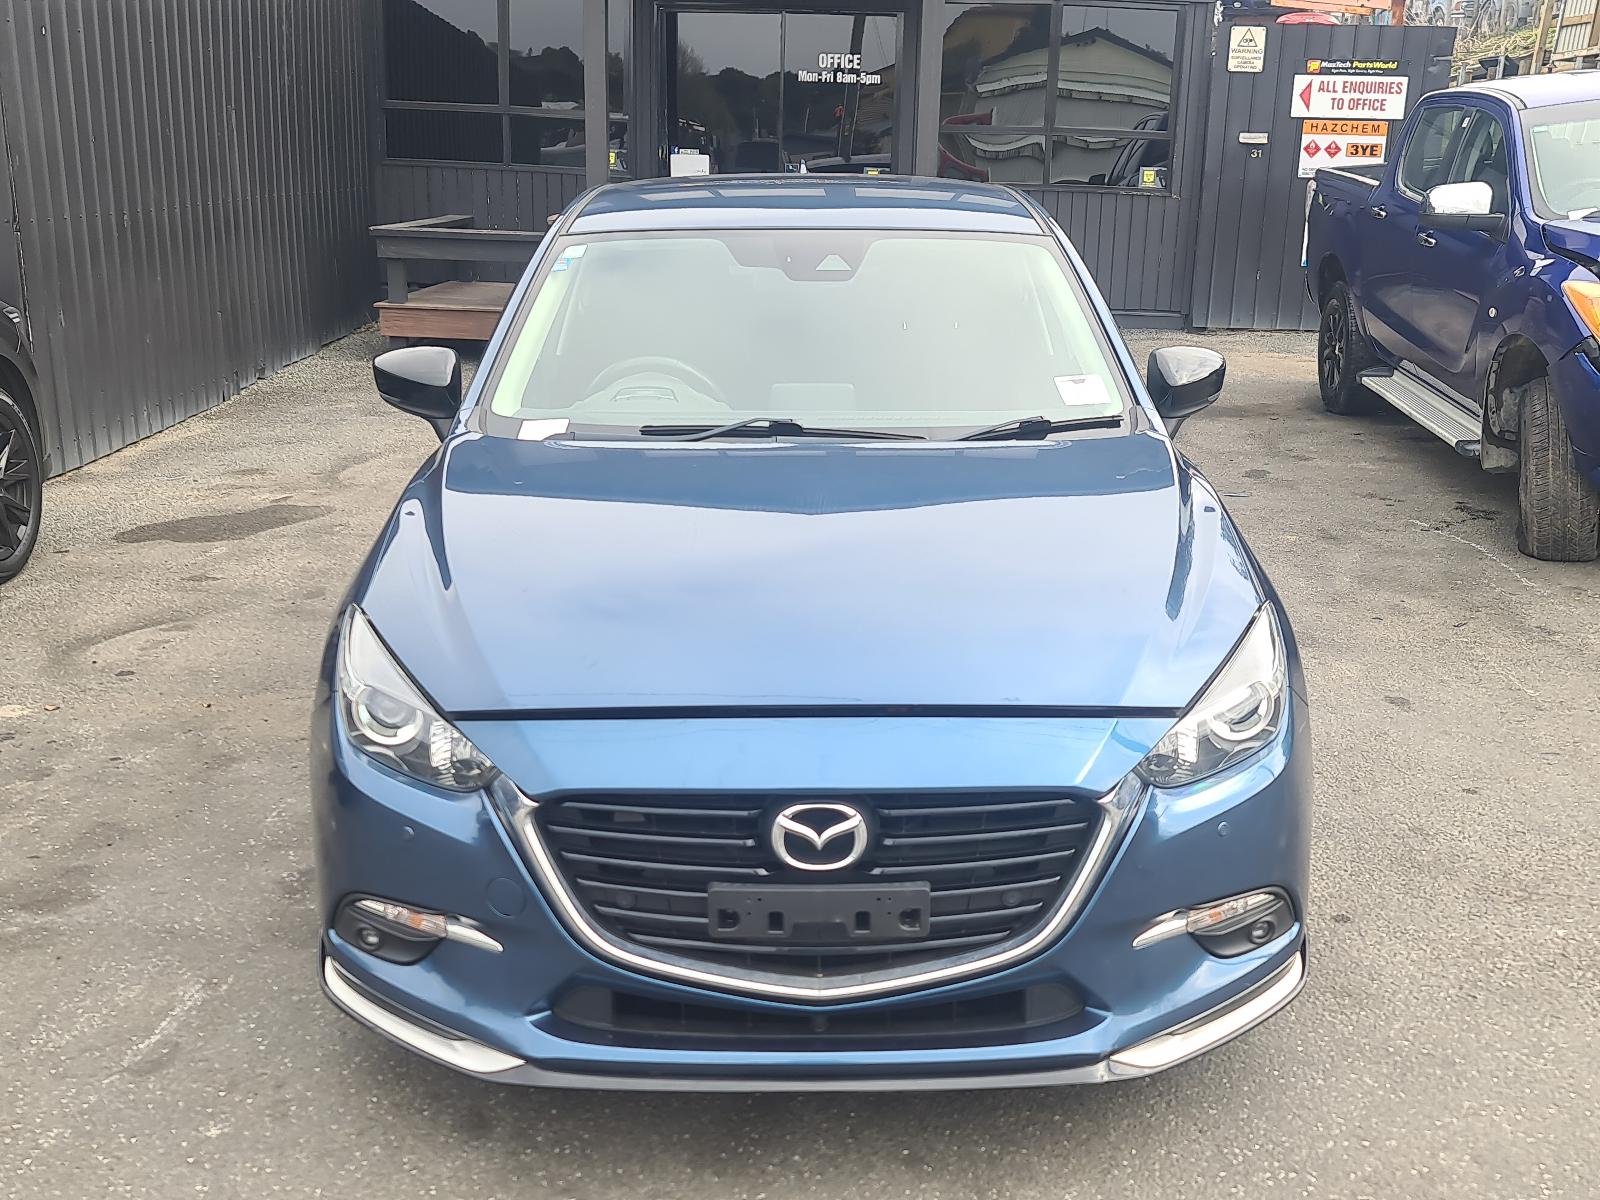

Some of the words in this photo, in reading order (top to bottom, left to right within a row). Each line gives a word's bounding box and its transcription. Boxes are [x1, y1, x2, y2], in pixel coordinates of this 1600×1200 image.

[818, 53, 861, 69] OFFICE
[798, 70, 834, 82] Mon-Fri
[836, 71, 881, 85] 8am-5pm
[1318, 80, 1338, 93] ALL
[1342, 81, 1403, 95] ENQUIRIES
[1331, 97, 1344, 110] TO
[1347, 98, 1387, 111] OFFICE
[1310, 122, 1380, 133] HAZCHEM
[1250, 149, 1262, 158] 31
[1350, 144, 1379, 156] 3YE
